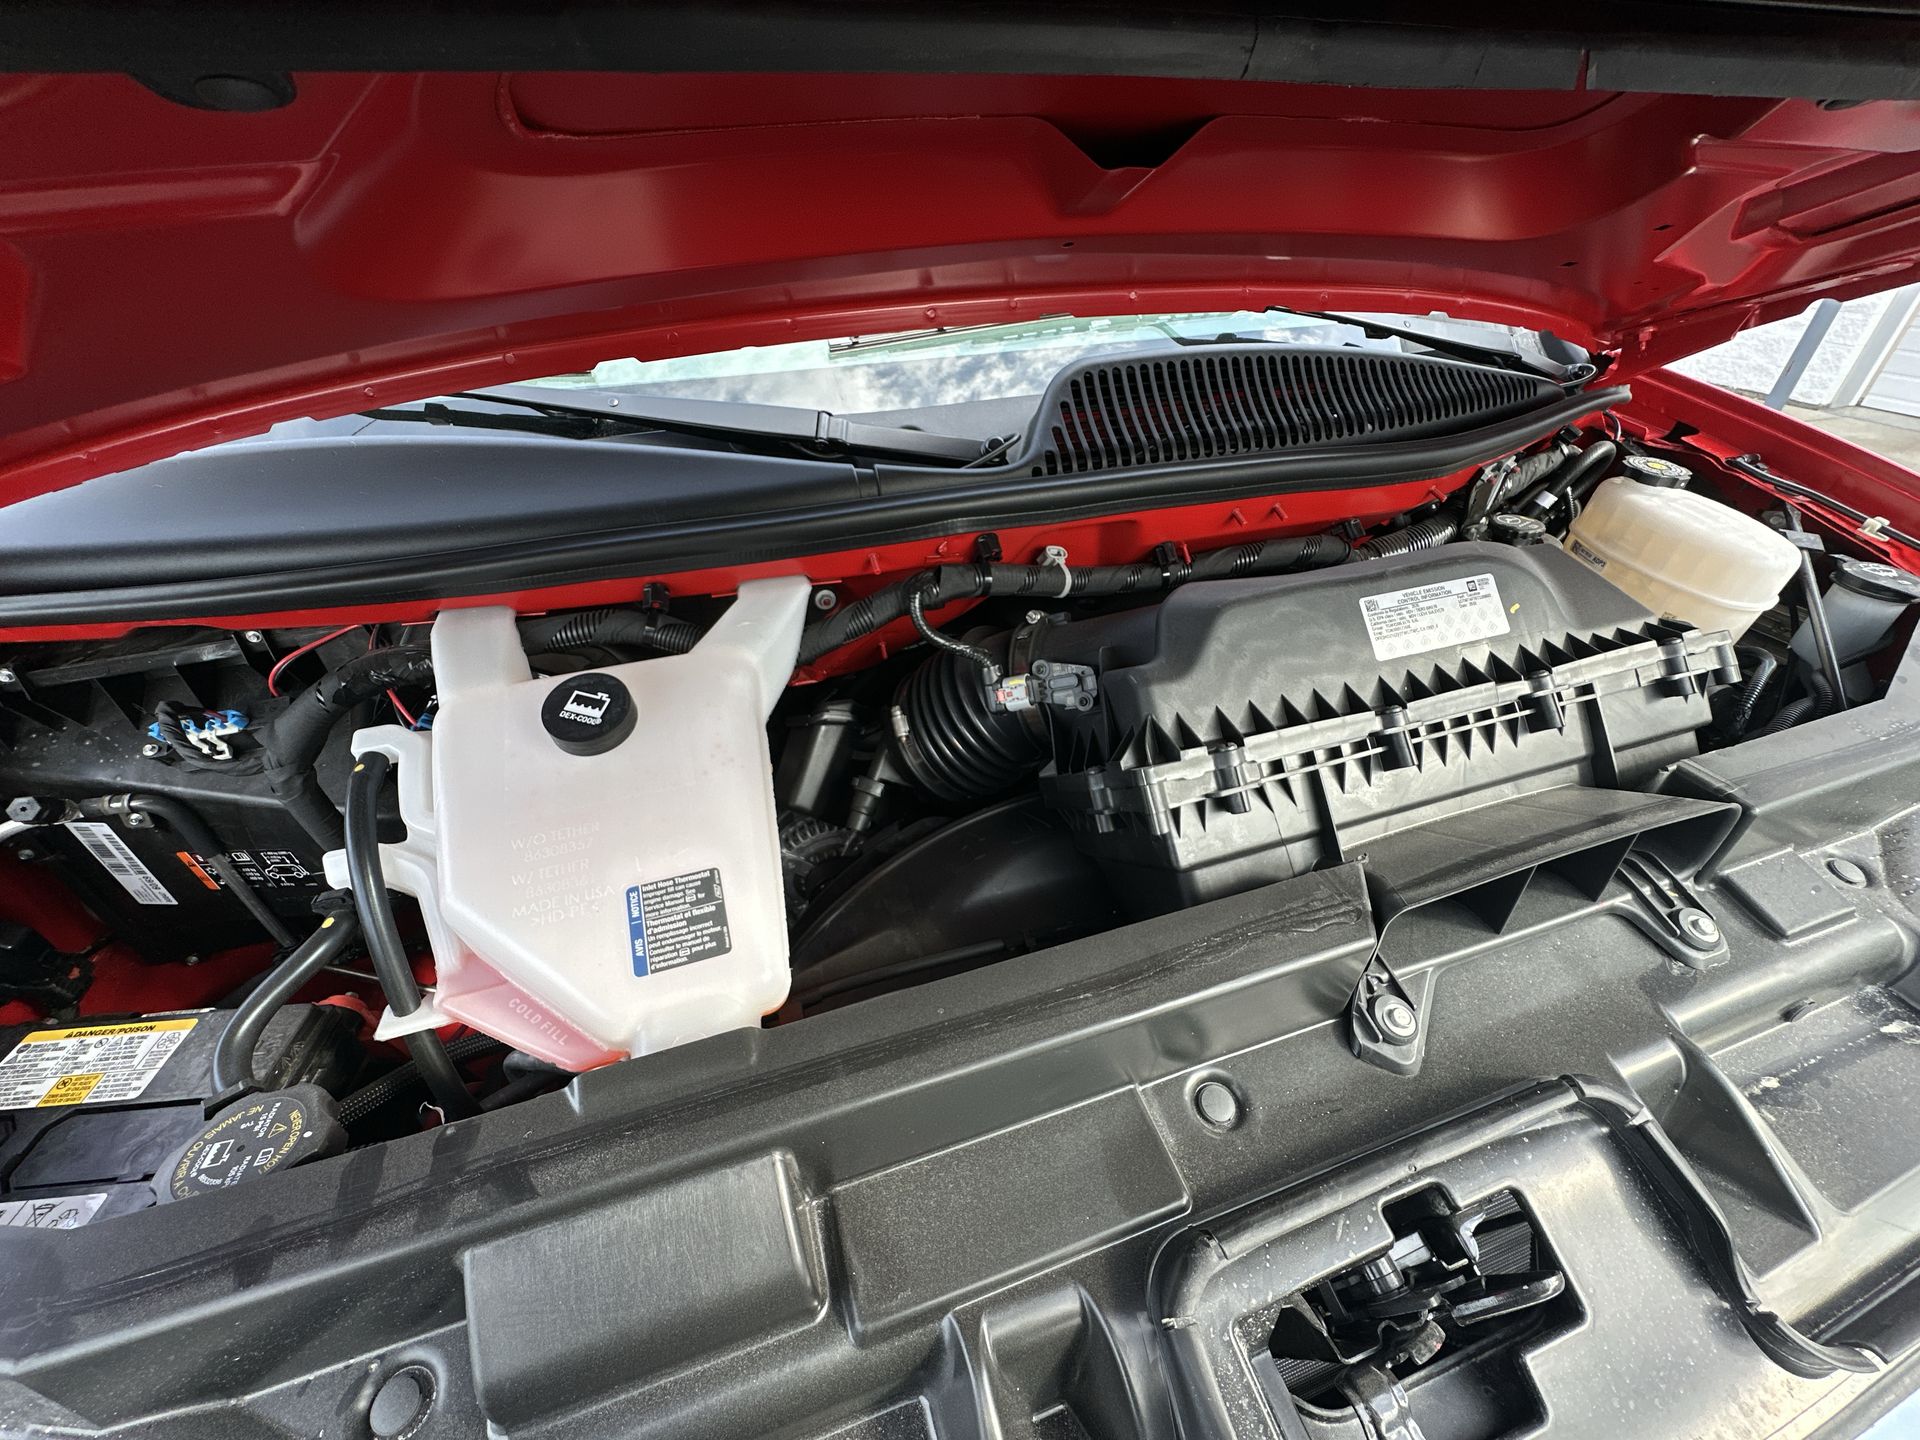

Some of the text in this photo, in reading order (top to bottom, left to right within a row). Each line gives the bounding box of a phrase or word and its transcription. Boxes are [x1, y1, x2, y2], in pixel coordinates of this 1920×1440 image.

[1397, 596, 1420, 604] CONTROL
[1421, 590, 1452, 600] INFORMATION
[1402, 586, 1445, 598] VEHICLE EMISSION
[642, 884, 657, 892] Inlet
[658, 880, 674, 888] Hose
[674, 870, 710, 884] Thermostat
[512, 886, 616, 918] MADE IN USA
[630, 890, 640, 918] NOTICE
[643, 889, 666, 899] Improper
[645, 903, 664, 911] Service
[665, 898, 684, 907] Manual
[646, 913, 684, 927] Thermostat
[692, 905, 716, 916] flexible
[647, 920, 687, 935] d'admission
[634, 938, 644, 956] AVIS
[73, 1025, 156, 1038] DANGER/POISON
[508, 998, 569, 1046] COLD FILL
[247, 1105, 264, 1116] NE
[256, 1102, 282, 1138] RADIATOR
[204, 1111, 245, 1139] JAMAIS
[279, 1132, 300, 1154] OPEN
[175, 1141, 203, 1181] OUVRIR
